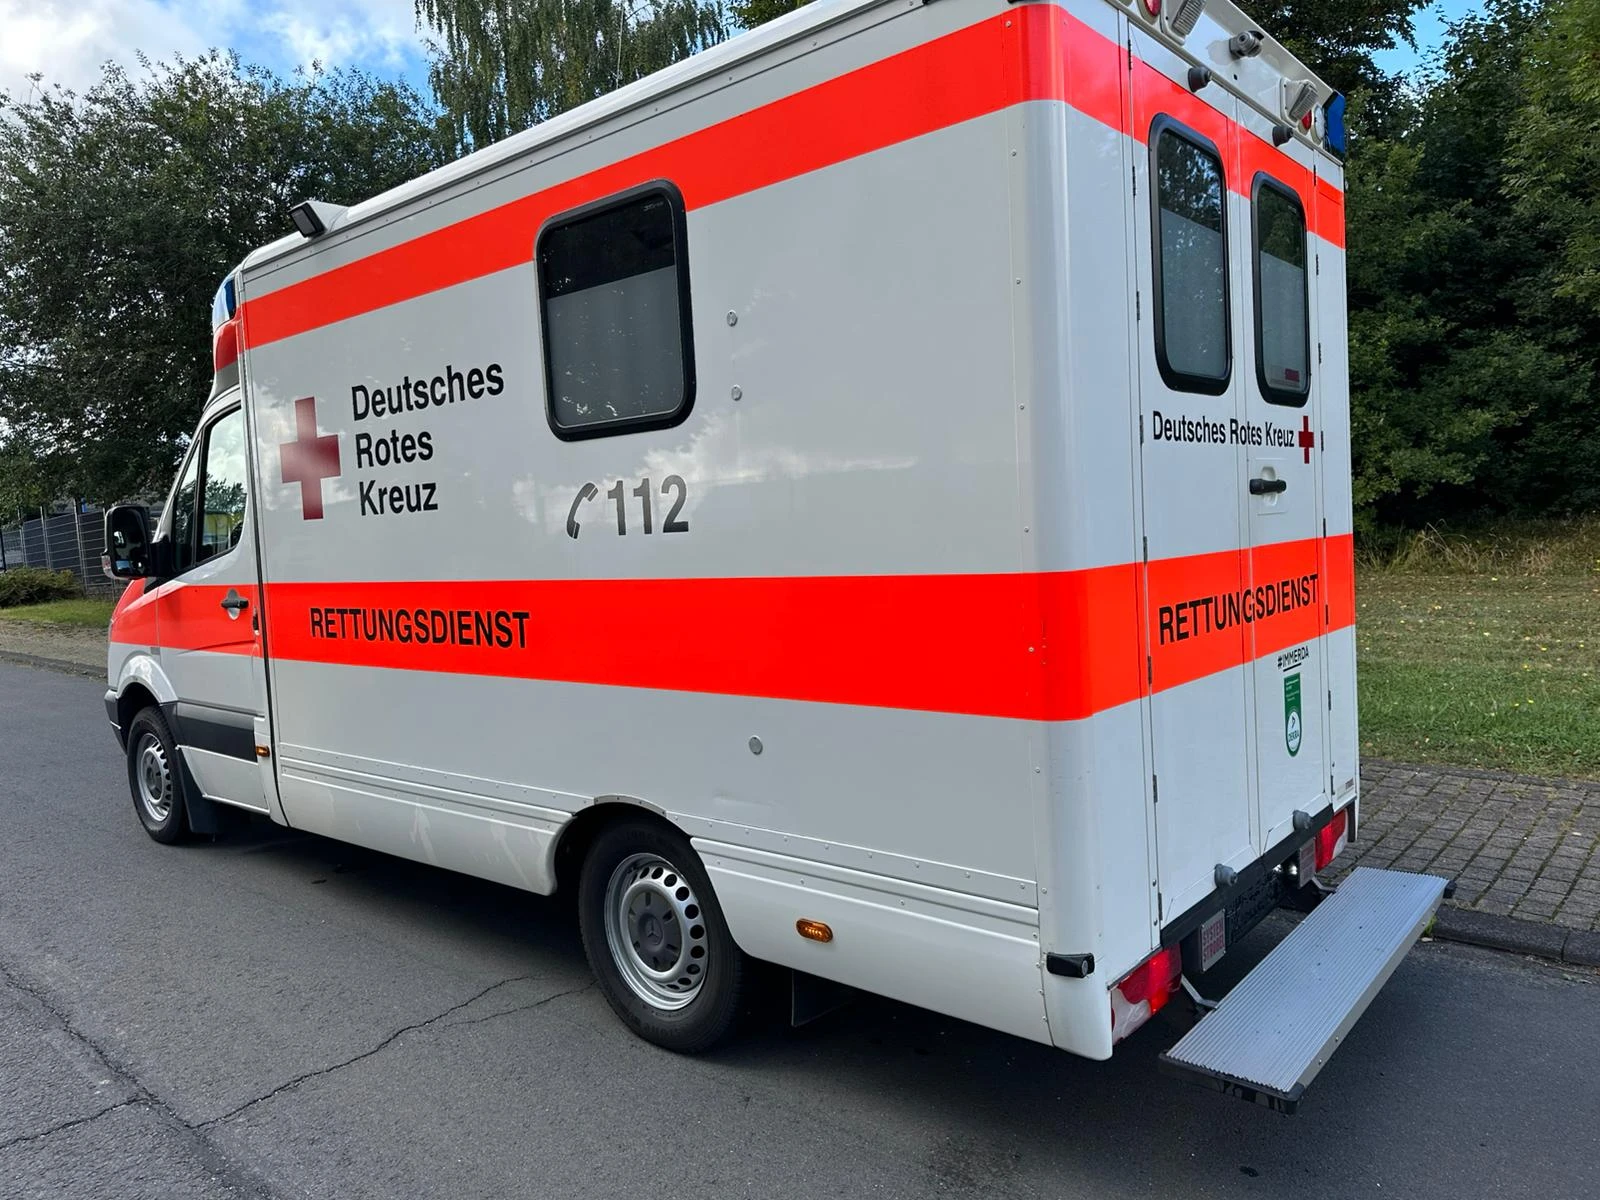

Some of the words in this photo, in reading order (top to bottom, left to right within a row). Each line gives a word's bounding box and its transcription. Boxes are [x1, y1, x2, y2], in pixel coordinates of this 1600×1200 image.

[351, 362, 505, 422] Deutsches
[355, 430, 434, 469] Rotes
[1152, 410, 1226, 444] Deutsches
[1229, 418, 1262, 446] Rotes
[1265, 421, 1295, 448] Kreuz
[358, 479, 439, 517] Kreuz
[607, 473, 690, 537] 112
[309, 606, 531, 649] RETTUNGSDIENST
[1158, 573, 1319, 646] RETTUNGSDIENST
[1277, 645, 1310, 670] #IMMERDA
